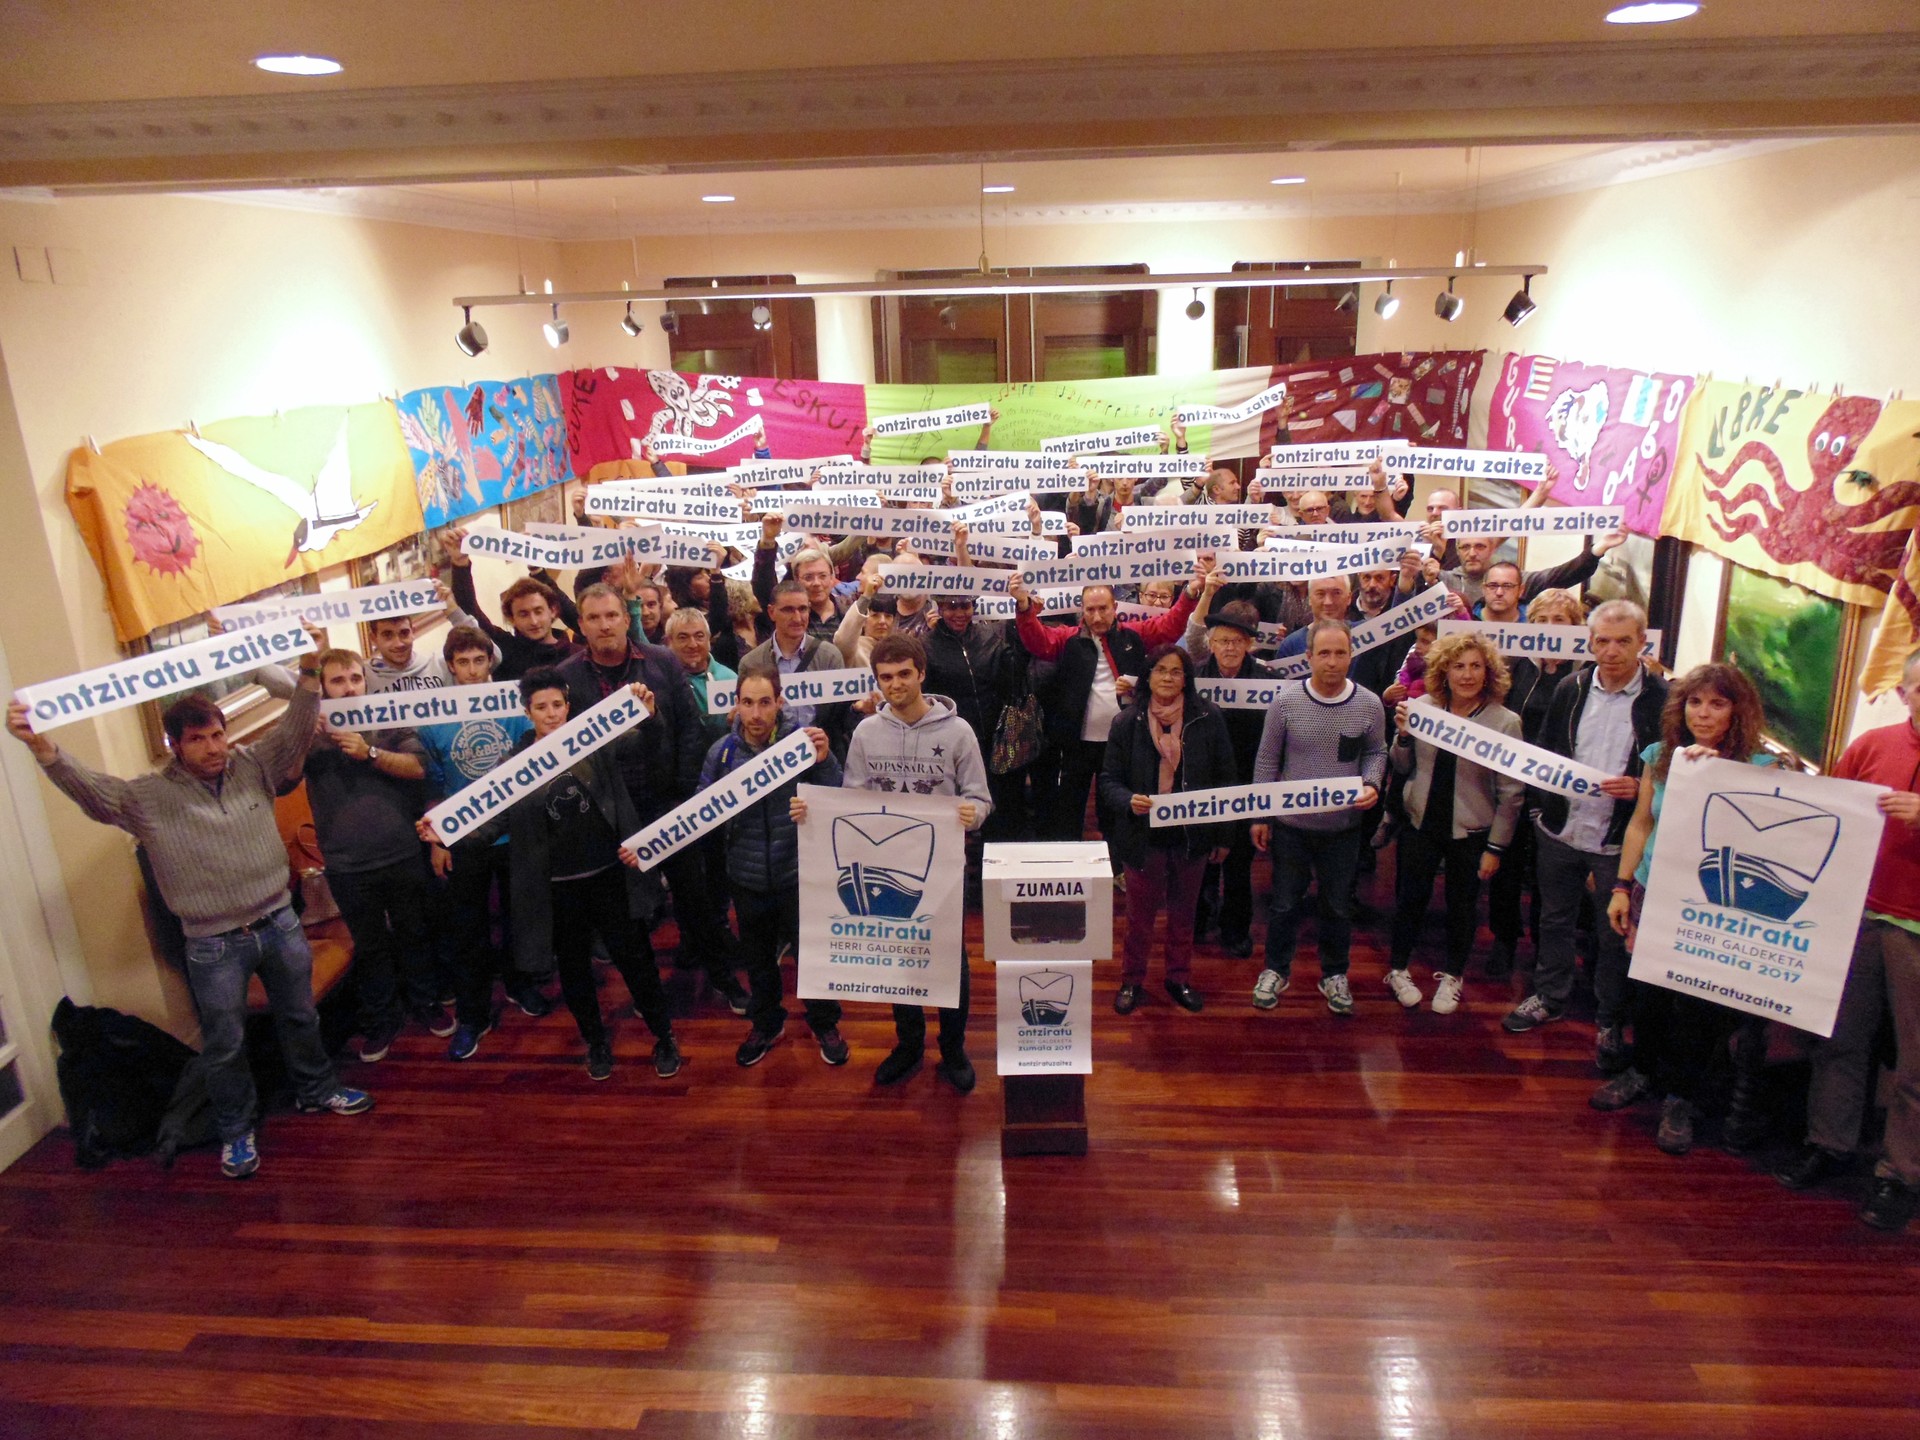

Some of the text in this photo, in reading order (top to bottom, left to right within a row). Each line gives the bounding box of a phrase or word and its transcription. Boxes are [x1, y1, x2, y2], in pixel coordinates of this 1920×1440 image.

[1178, 390, 1285, 423] ontziratu zaitez
[876, 408, 988, 433] ontziratu zaitez
[653, 439, 717, 450] ontziratu
[1045, 431, 1159, 452] ontziratu zaitez
[952, 456, 1068, 470] ontziratu zaitez
[1080, 457, 1206, 474] ontziratu zaitez
[1275, 445, 1380, 464] ontziratu zai
[1386, 453, 1544, 476] ontziratu zaitez
[734, 466, 804, 484] ontziratu
[819, 469, 945, 485] ontziratu zaitez
[955, 473, 1086, 492] ontziratu zaitez
[1259, 472, 1396, 488] ontziratu zaiz
[590, 495, 739, 518] ontziratu zaitez
[827, 494, 878, 507] zaitez
[974, 498, 1027, 518] zaitez
[788, 511, 884, 531] ontziratu
[891, 515, 951, 534] zaitez
[1012, 518, 1063, 532] zaez
[1125, 508, 1269, 526] ontziratu zaitez
[1447, 511, 1620, 532] ontziratu zaitez
[468, 532, 662, 564] ontziratu zaitez
[911, 537, 1057, 561] ontziatu zaitez
[1078, 534, 1231, 557] ontziratu zaitez
[1023, 558, 1195, 584] ontziratu zaitez
[1223, 557, 1328, 577] ontziratu
[1336, 543, 1407, 571] zaitez
[884, 571, 975, 591] ontziratu
[361, 585, 439, 614] zaitez
[1381, 592, 1450, 636] zaitez
[33, 627, 308, 721] ontziratu zaitez
[329, 696, 458, 727] ontziratu
[1408, 711, 1603, 798] ontziratu zaitez
[441, 698, 641, 835] ontziratu zaitez
[636, 742, 813, 862] ontziratu zaitez
[1156, 786, 1359, 821] ontziratu zaitez
[1016, 881, 1084, 898] ZUMAIA
[830, 920, 932, 942] ontziratu
[1680, 906, 1811, 953] ontziratu
[830, 941, 931, 956] HERRI GALDEKETA
[1676, 927, 1805, 970] HERRI GALDEKETA
[830, 954, 930, 969] zumaia 2017
[1673, 941, 1801, 984] zumaia 2017
[828, 982, 929, 997] #ontziratuzaitez
[1666, 970, 1793, 1016] #ontziratuzaitez
[1018, 1028, 1072, 1037] ontziratu
[1018, 1044, 1052, 1052] zumaia
